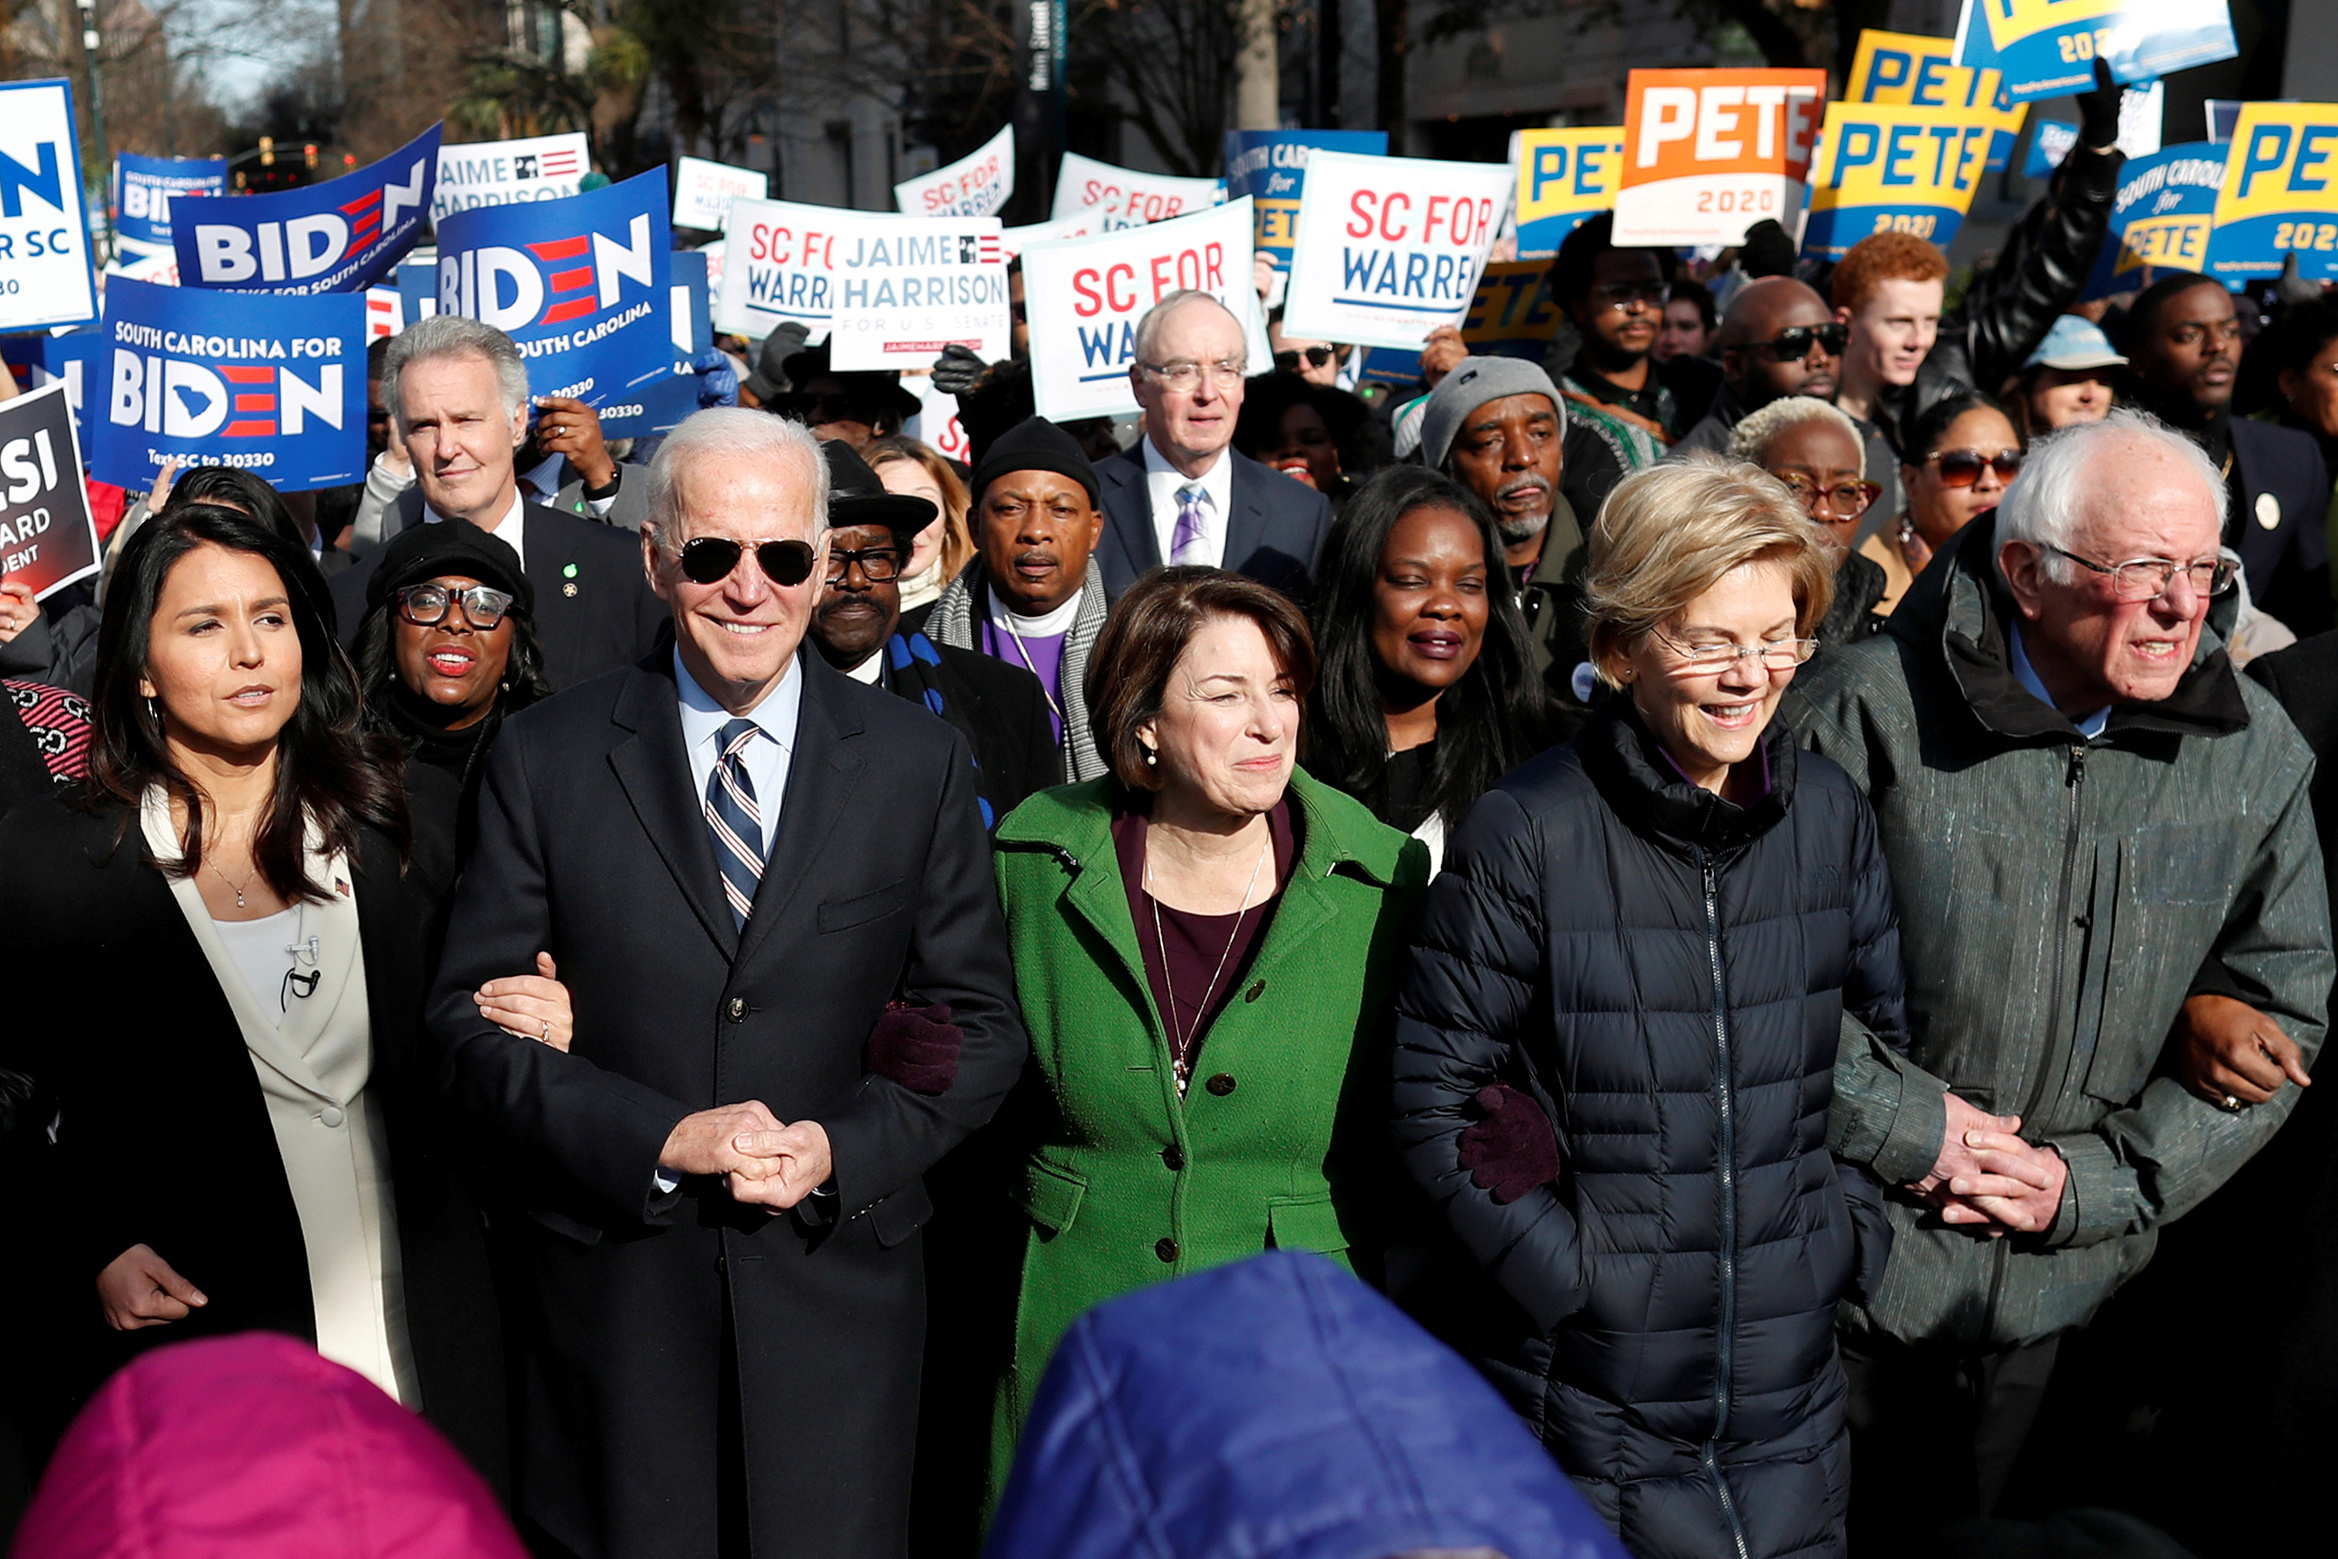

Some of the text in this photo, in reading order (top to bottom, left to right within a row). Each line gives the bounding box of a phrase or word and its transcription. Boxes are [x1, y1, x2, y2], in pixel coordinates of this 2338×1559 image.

[2057, 27, 2116, 63] 202
[1637, 85, 1818, 168] PETE
[441, 157, 508, 186] AIME
[1532, 144, 1623, 202] PE
[1830, 122, 1984, 190] PETE
[923, 154, 998, 211] SC FOR
[1265, 172, 1296, 196] for
[1698, 189, 1774, 213] 2020
[2115, 158, 2229, 214] SOUTH CAROLI
[2152, 189, 2183, 215] for
[195, 157, 426, 283] BIDEN
[1126, 192, 1183, 222] FOR
[1254, 207, 1299, 239] ET
[1346, 189, 1493, 246] SC FOR
[26, 228, 70, 257] SC
[751, 223, 792, 264] SC
[845, 235, 953, 268] JAIME
[2120, 225, 2201, 264] PETE
[2273, 222, 2338, 251] 202
[310, 261, 359, 297] SOUTH
[358, 216, 418, 268] CAROLINA
[441, 212, 653, 332] BIDEN
[749, 265, 834, 309] WARR
[844, 274, 1004, 308] HARRISON
[1073, 241, 1224, 317] SC FOR
[115, 320, 343, 359] SOUTH CAROLINA FOR
[515, 334, 571, 359] OUTH
[572, 301, 653, 348] CAROLINA
[843, 319, 886, 331] FOR
[954, 314, 1004, 329] SENATE
[110, 348, 344, 438] BIDEN
[176, 453, 199, 468] SC
[201, 453, 220, 467] to
[223, 452, 275, 468] 30330
